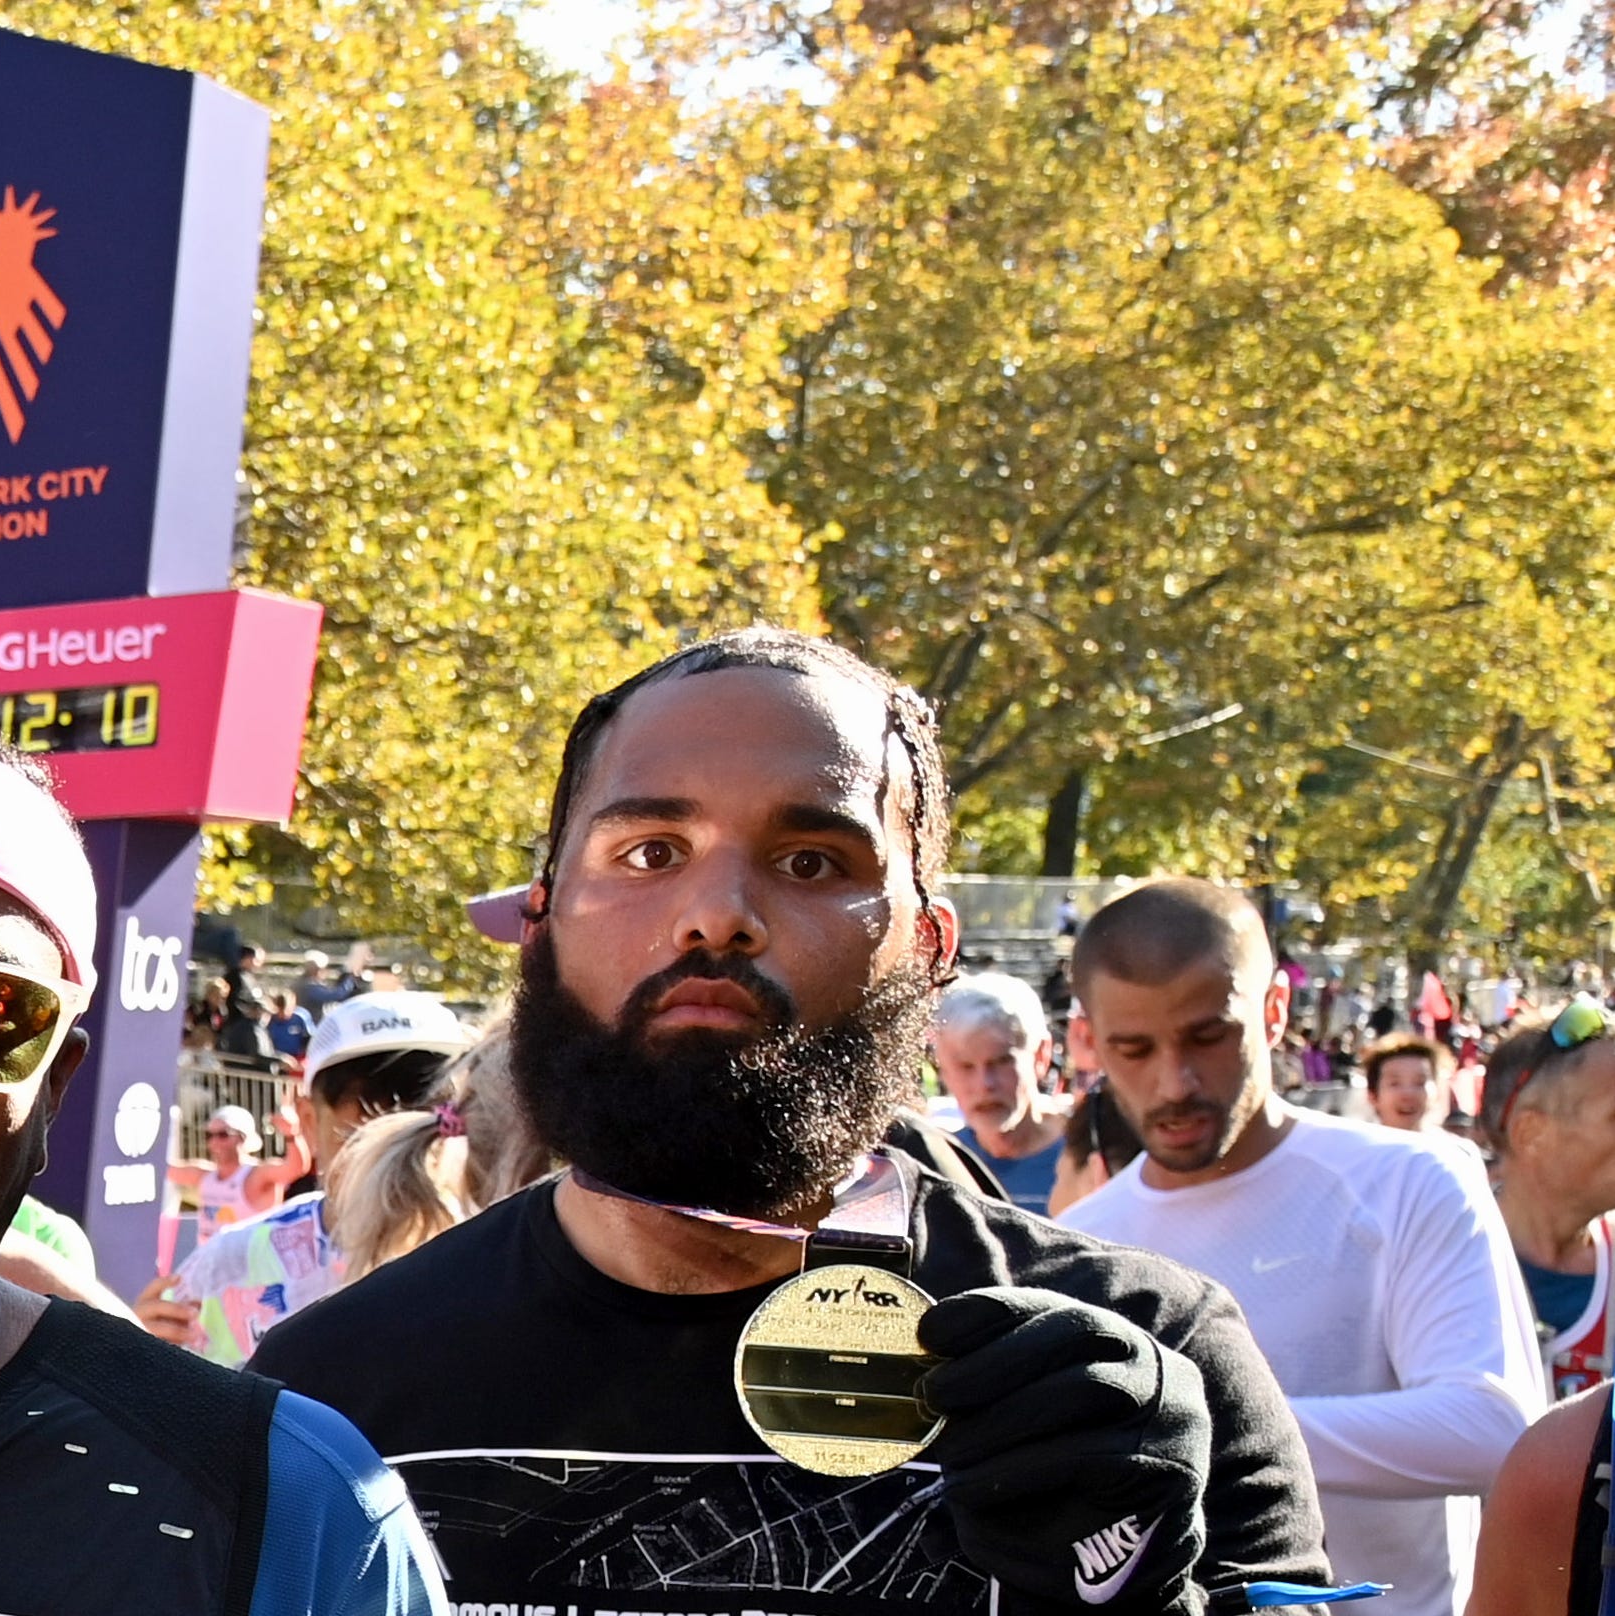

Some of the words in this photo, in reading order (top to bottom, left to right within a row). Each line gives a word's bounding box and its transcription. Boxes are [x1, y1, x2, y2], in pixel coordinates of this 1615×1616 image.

[38, 465, 108, 500] CITY
[119, 915, 182, 1012] tcs
[1070, 1514, 1144, 1580] NIKE
